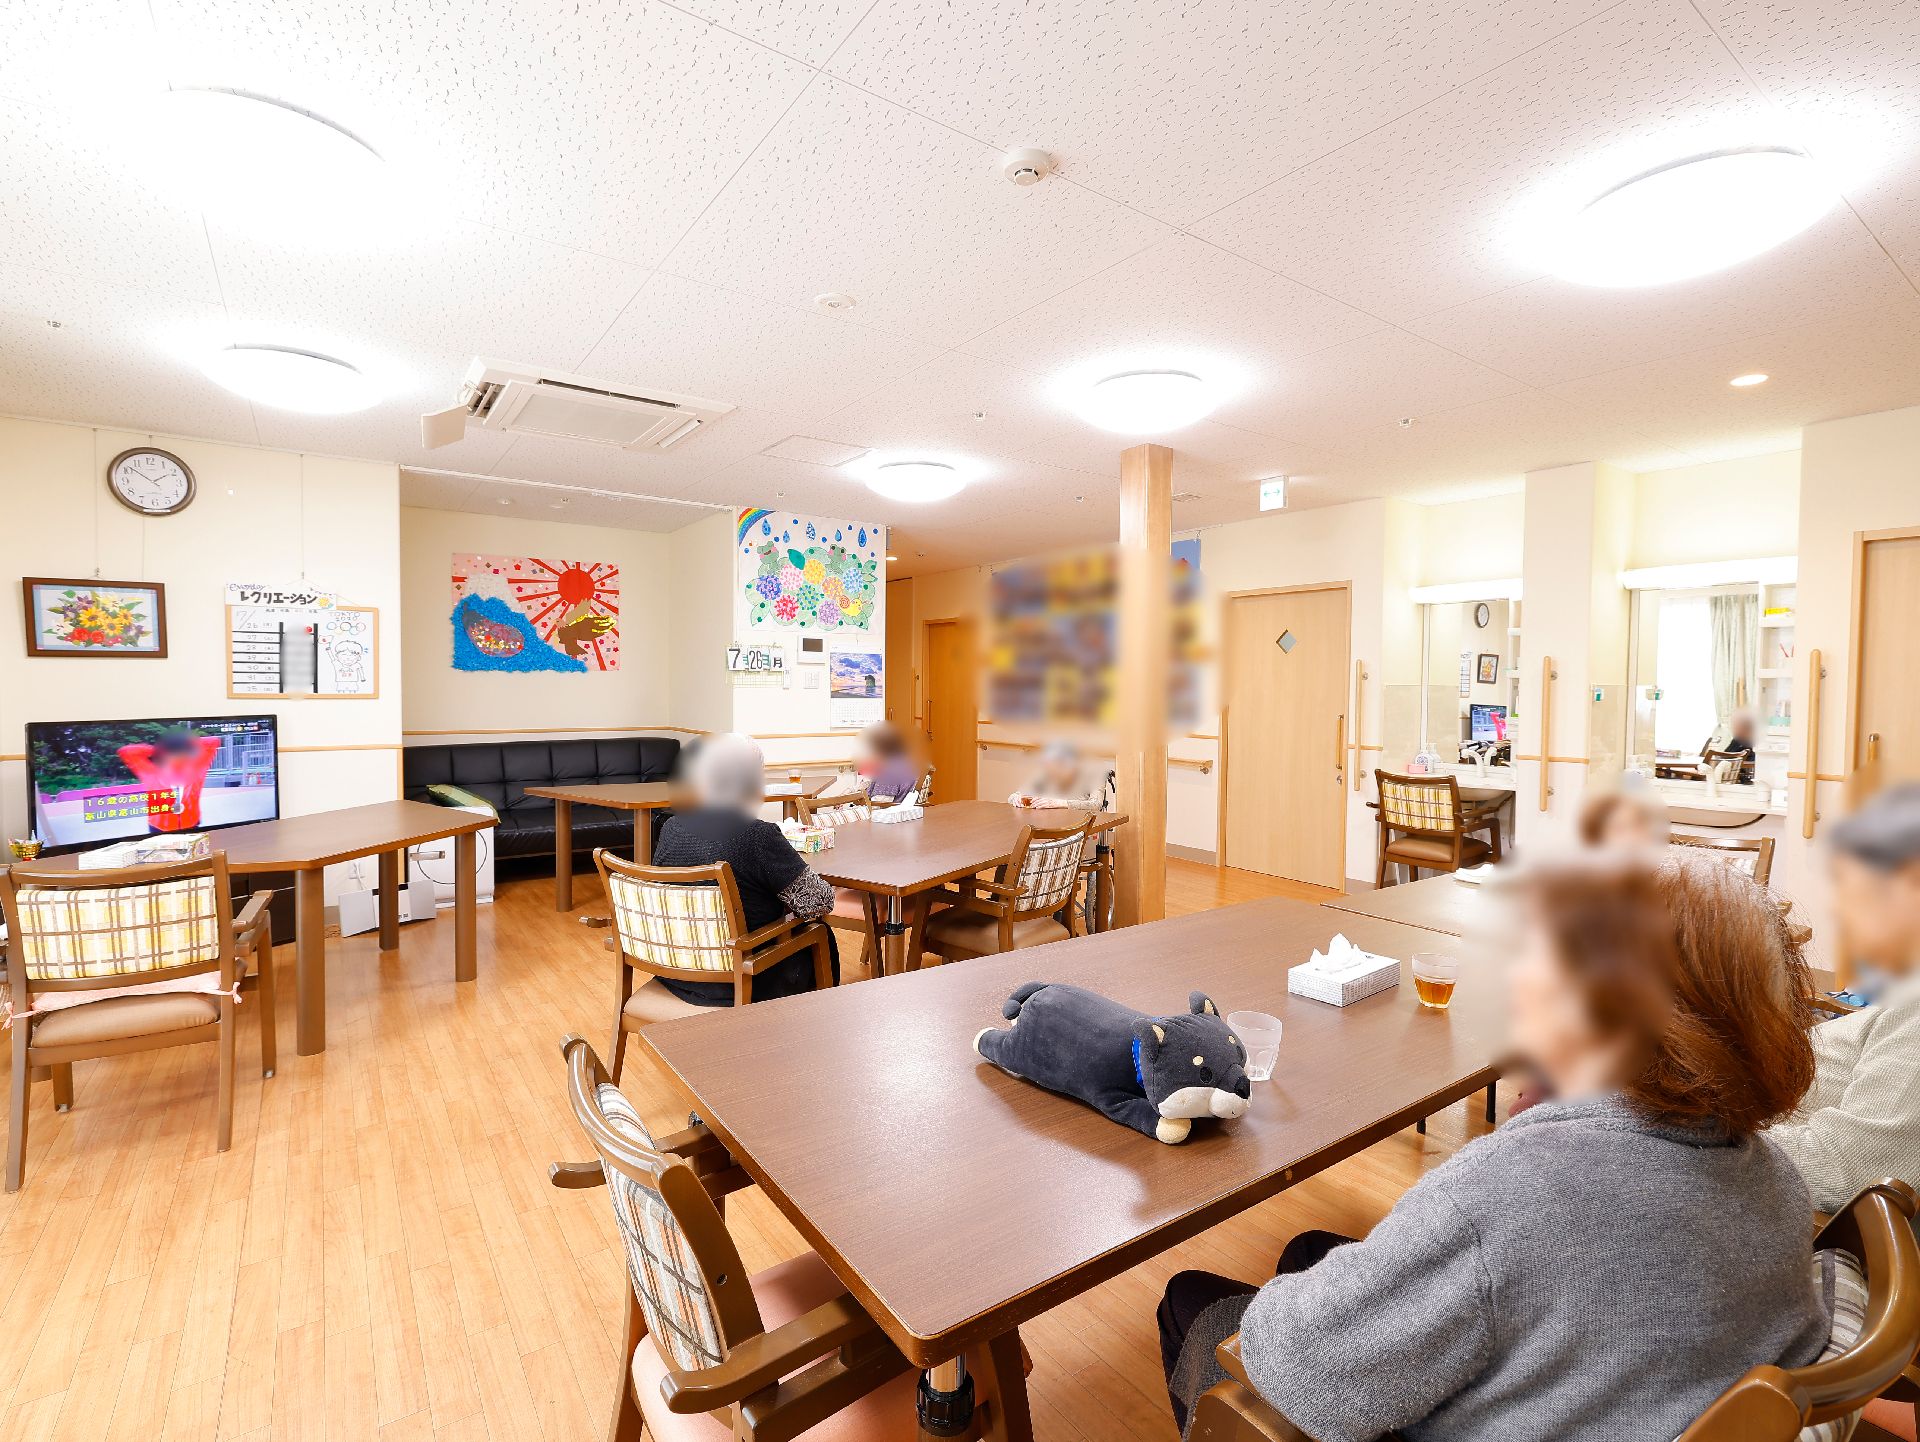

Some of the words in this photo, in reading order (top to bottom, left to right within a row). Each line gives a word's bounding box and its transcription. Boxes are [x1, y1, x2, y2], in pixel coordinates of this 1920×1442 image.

[133, 459, 141, 468] 11
[146, 457, 155, 466] 12
[161, 461, 166, 469] 1
[170, 469, 177, 477] 2
[173, 489, 179, 498] 4
[139, 495, 144, 504] 7
[151, 498, 159, 507] 6
[240, 591, 318, 605] レクリエーション
[773, 656, 783, 668] 月
